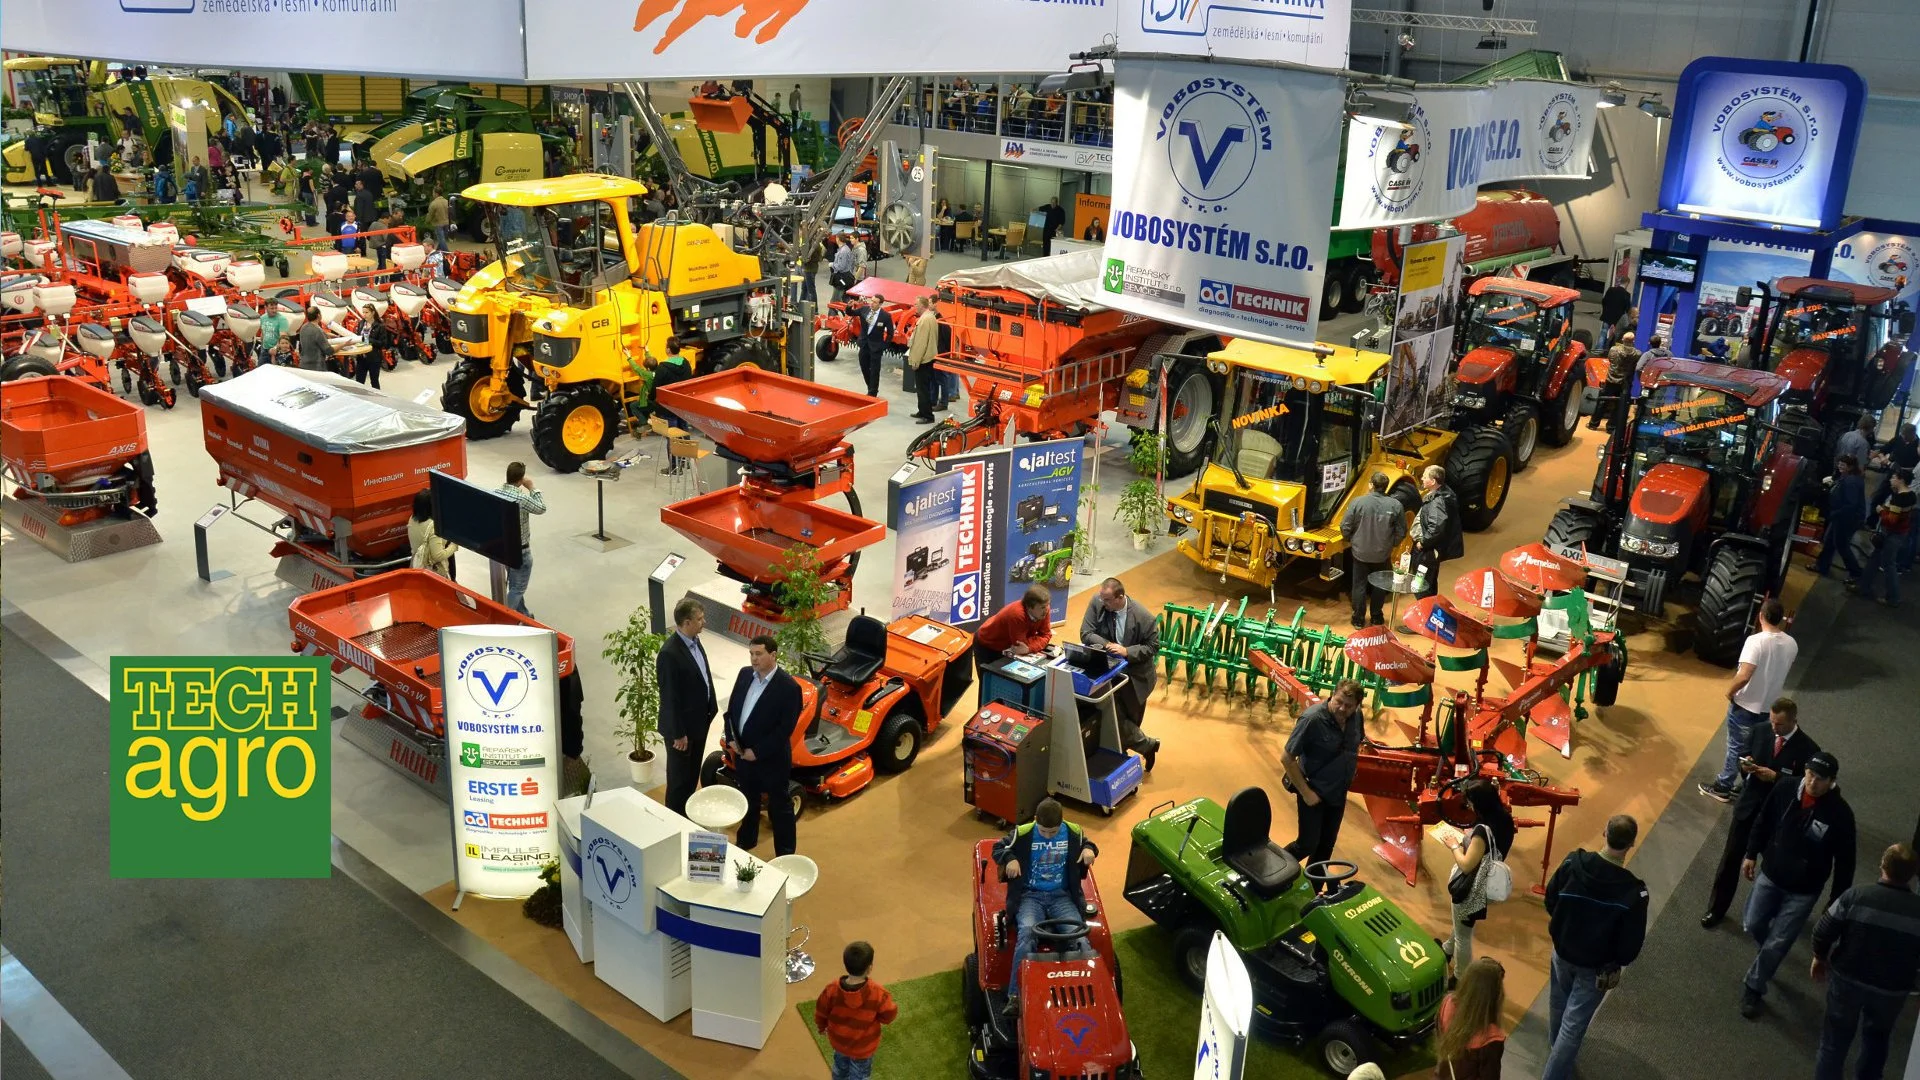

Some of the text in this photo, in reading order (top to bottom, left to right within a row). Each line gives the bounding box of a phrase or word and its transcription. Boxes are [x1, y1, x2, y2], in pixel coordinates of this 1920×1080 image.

[1212, 26, 1324, 45] zemědělská lesní komunální
[563, 91, 578, 100] SHOP
[1156, 77, 1273, 151] VOBOSYSTÉM
[1712, 86, 1819, 142] VOBOSYSTÉM s.r.o.
[1743, 156, 1770, 165] CASE
[913, 169, 923, 180] 25
[1716, 156, 1805, 190] www.vobosystem.cz
[1388, 179, 1405, 188] CASE
[1112, 208, 1314, 272] VOBOSYSTÉM s.r.o.
[1125, 273, 1162, 288] INSTITUT
[1235, 291, 1305, 317] TECHNIK
[1806, 303, 1823, 313] ZDE
[591, 318, 610, 329] G8
[1198, 306, 1235, 319] diagnostika
[1240, 314, 1278, 328] technologie
[1285, 323, 1306, 333] servis
[1231, 403, 1290, 430] NOVINKA
[108, 442, 138, 455] AXIS
[1031, 448, 1076, 473] jaltest
[986, 462, 995, 490] servis
[1051, 466, 1075, 478] AGV
[914, 487, 957, 517] jaltest
[957, 469, 976, 569] TECHNIK
[984, 498, 995, 554] technologie
[981, 562, 992, 617] diagnostika
[295, 621, 317, 638] AXIS
[1350, 634, 1388, 648] NOVINKA
[337, 638, 376, 675] RAUCH
[1375, 661, 1408, 671] Knock-on
[457, 720, 519, 735] VOBOSYSTÉM
[389, 737, 440, 785] RAUCH
[468, 780, 519, 796] ERSTE
[469, 795, 495, 804] Leasing
[491, 815, 545, 827] TECHNIK
[468, 846, 541, 856] IL IMPULS
[1031, 840, 1069, 851] STYLES
[481, 852, 551, 862] LEASING
[1355, 896, 1383, 914] KRONE
[1046, 970, 1080, 979] CASE
[1341, 958, 1374, 996] KRONE
